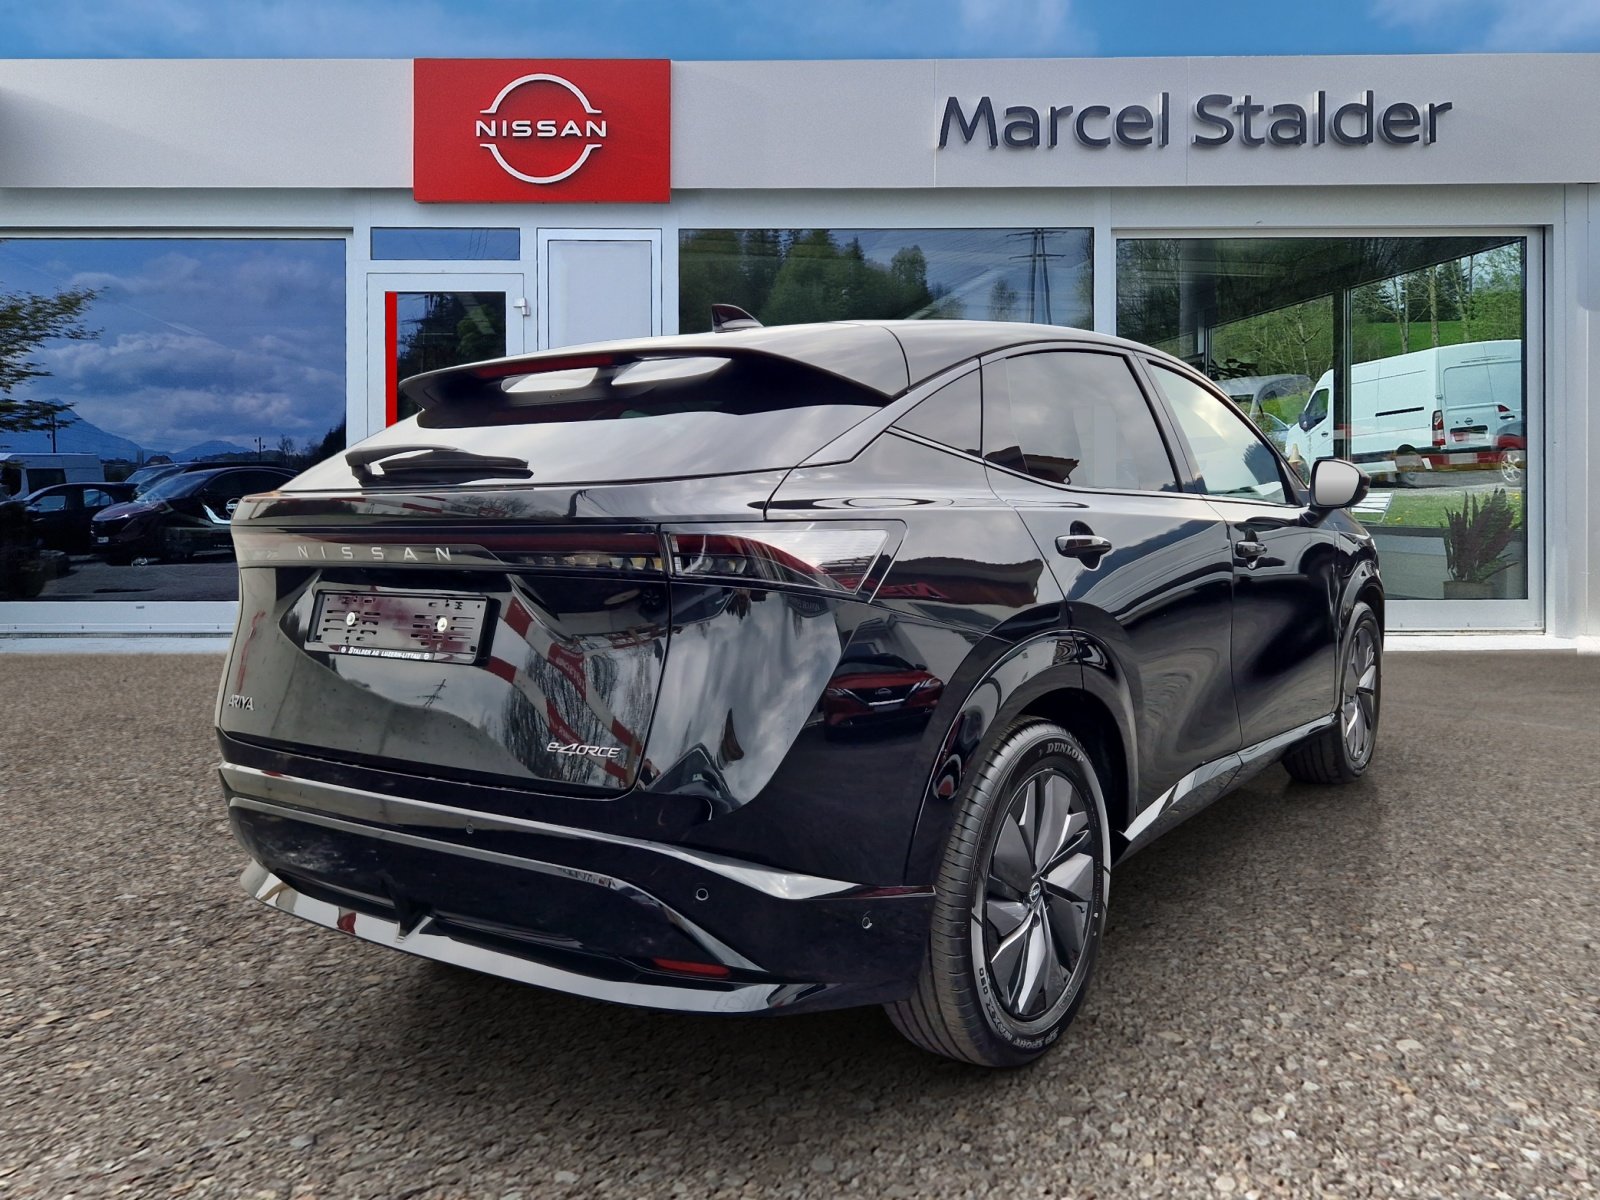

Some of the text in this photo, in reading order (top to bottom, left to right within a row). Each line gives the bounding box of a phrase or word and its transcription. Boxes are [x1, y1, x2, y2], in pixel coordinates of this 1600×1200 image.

[938, 89, 1453, 150] Marcel Stalder
[475, 120, 606, 138] NISSAN
[297, 545, 452, 561] NISSAN
[227, 694, 254, 711] ARIYA
[1046, 742, 1084, 762] DUNLOP
